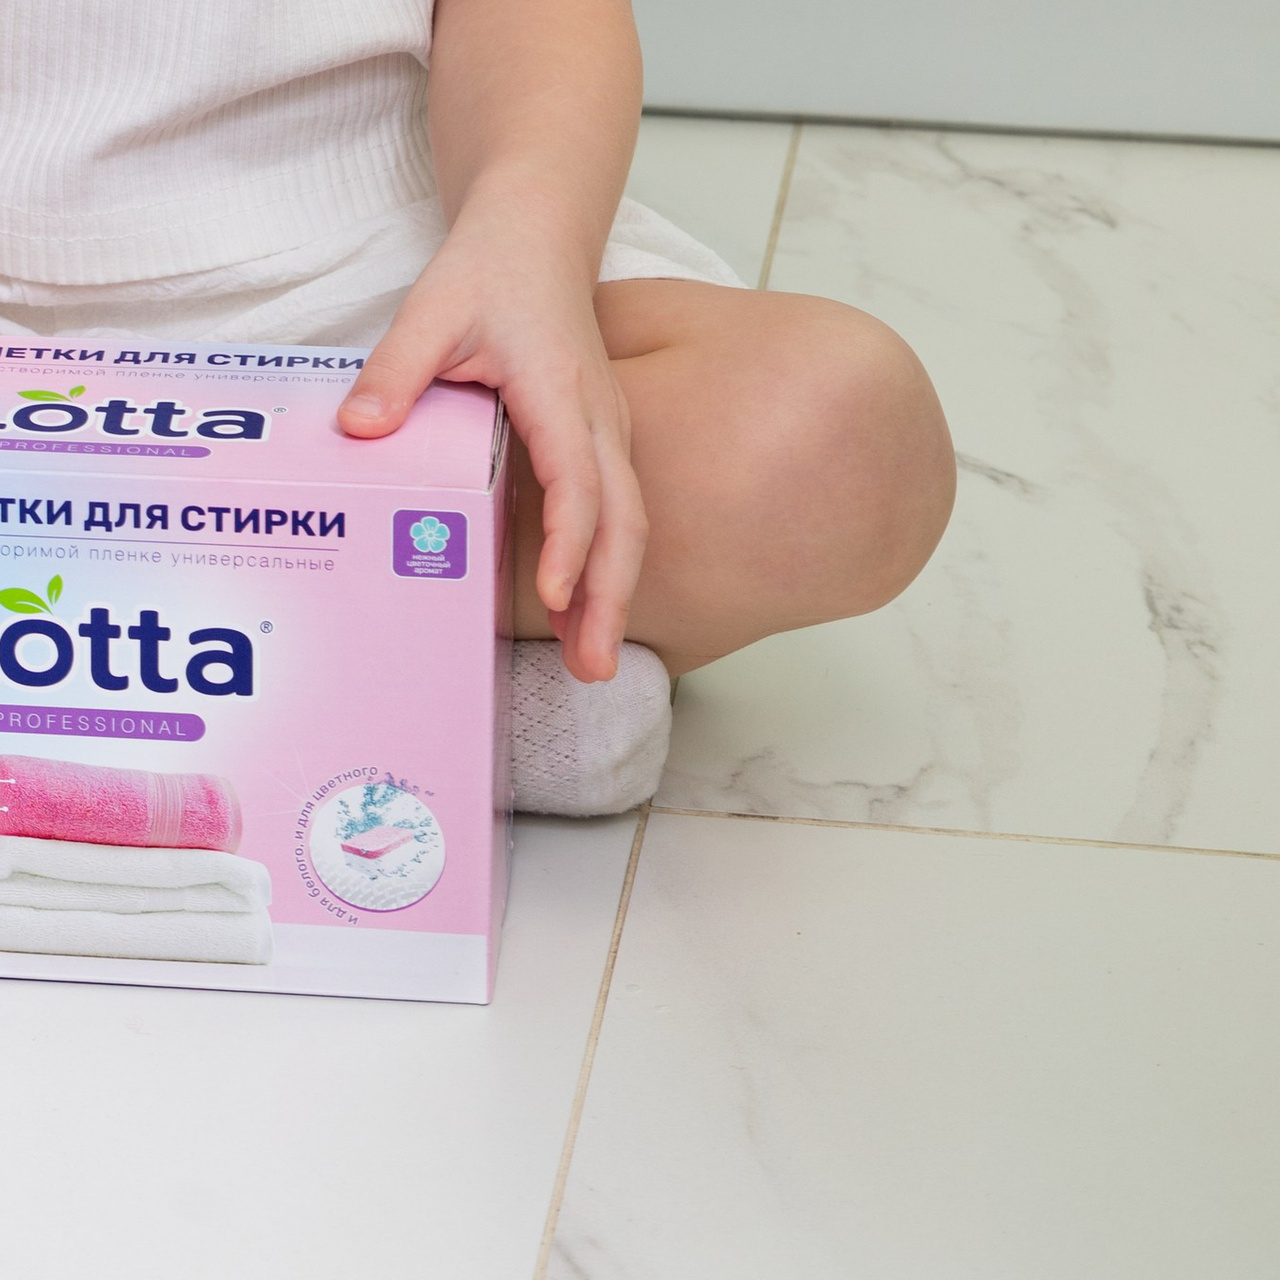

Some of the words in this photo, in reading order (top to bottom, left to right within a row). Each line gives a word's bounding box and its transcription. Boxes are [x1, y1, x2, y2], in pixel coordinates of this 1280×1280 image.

[113, 351, 196, 365] ДЛЯ
[207, 353, 364, 370] СТИРКИ
[115, 371, 186, 380] пленке
[194, 372, 353, 385] универсальные
[83, 501, 169, 532] ДЛЯ
[181, 505, 346, 538] СТИРКИ
[89, 548, 162, 563] пленке
[170, 550, 336, 572] универсальные
[312, 766, 379, 802] цветного
[297, 801, 315, 828] для
[320, 897, 348, 919] для
[348, 915, 359, 925] и
